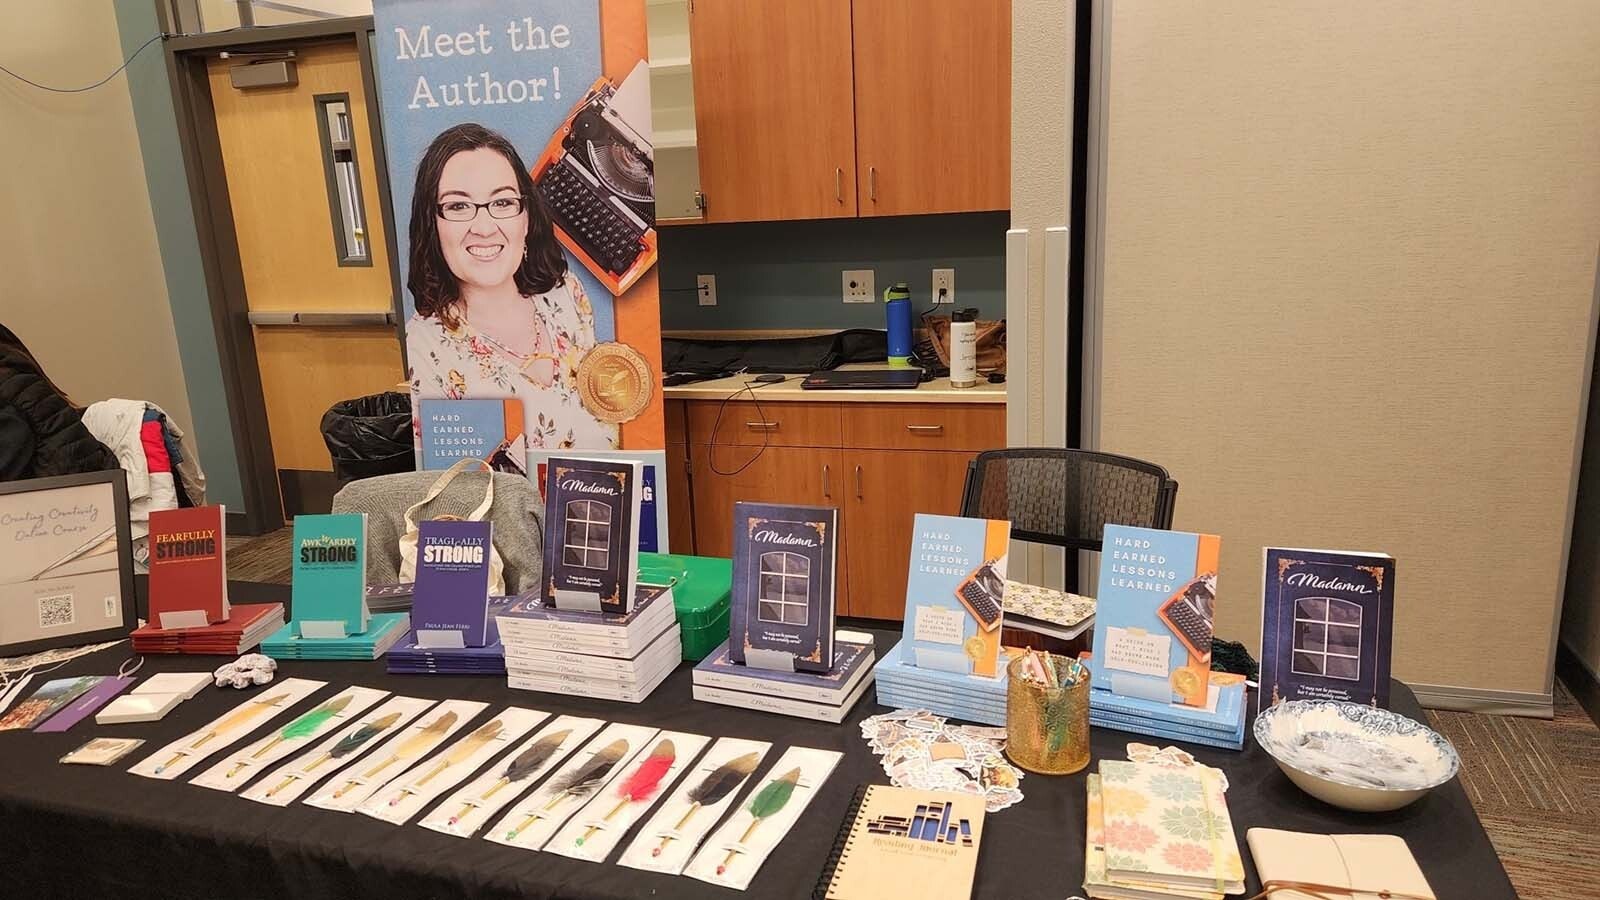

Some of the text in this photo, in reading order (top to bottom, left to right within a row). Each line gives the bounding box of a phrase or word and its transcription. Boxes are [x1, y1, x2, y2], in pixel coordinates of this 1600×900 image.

[395, 17, 571, 60] Meet the
[407, 66, 561, 109] Author!
[435, 449, 482, 457] LEARNED
[562, 479, 619, 496] Madamn
[156, 529, 216, 543] FEARFULLY
[754, 530, 818, 548] Madamn
[922, 531, 951, 541] HARD
[1115, 537, 1151, 549] HARD
[156, 538, 216, 560] STRONG
[300, 545, 357, 563] STRONG
[424, 545, 484, 564] STRONG
[921, 542, 962, 553] EARNED
[920, 554, 969, 566] LESSONS
[1113, 551, 1166, 565] EARNED
[919, 565, 966, 577] LEARNED
[1112, 564, 1176, 580] LESSONS
[1111, 578, 1172, 593] LEARNED
[1287, 572, 1372, 594] Madamn
